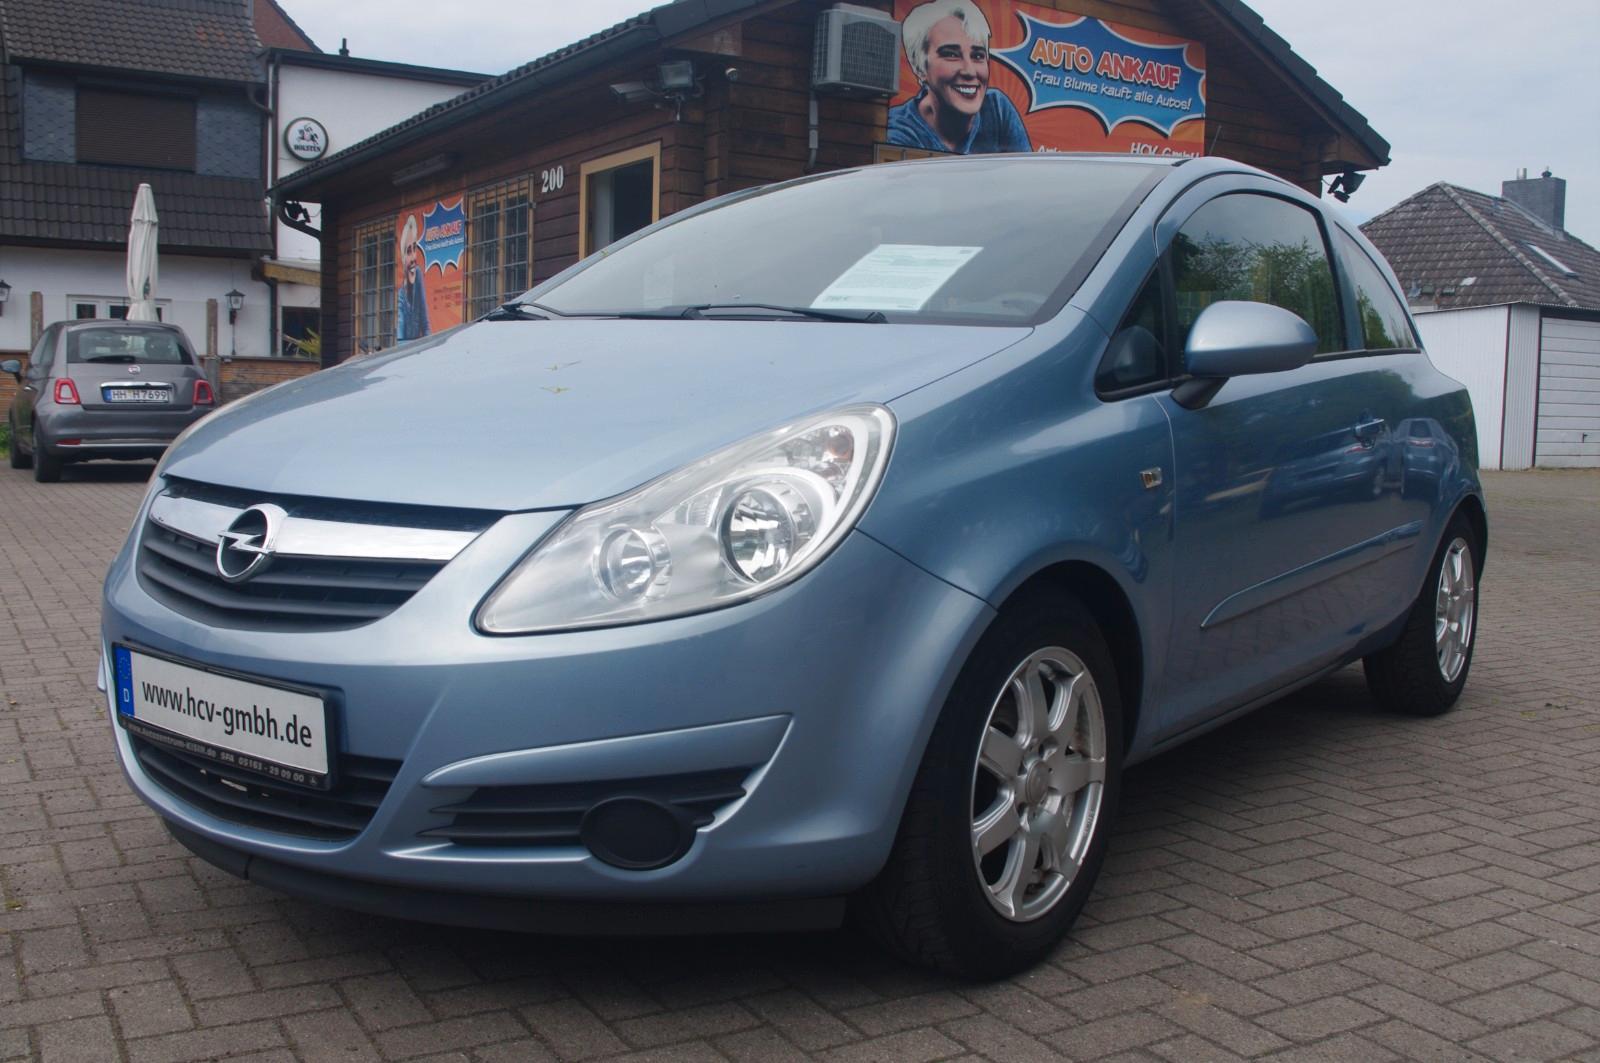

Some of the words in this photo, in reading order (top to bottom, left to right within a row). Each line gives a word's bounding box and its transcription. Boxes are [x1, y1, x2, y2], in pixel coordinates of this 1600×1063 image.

[1030, 38, 1093, 73] AUTO
[1096, 52, 1181, 90] ANKAUF
[1033, 71, 1060, 87] Frau
[1063, 75, 1098, 93] Blume
[1100, 82, 1132, 98] kauft
[1134, 91, 1153, 103] alle
[1157, 94, 1192, 110] Autos!
[1131, 142, 1158, 155] HCV
[541, 165, 564, 193] 200
[112, 390, 127, 399] HH
[142, 390, 167, 399] 7699
[123, 687, 130, 703] D
[142, 681, 312, 747] www.hcv-gmbh.de
